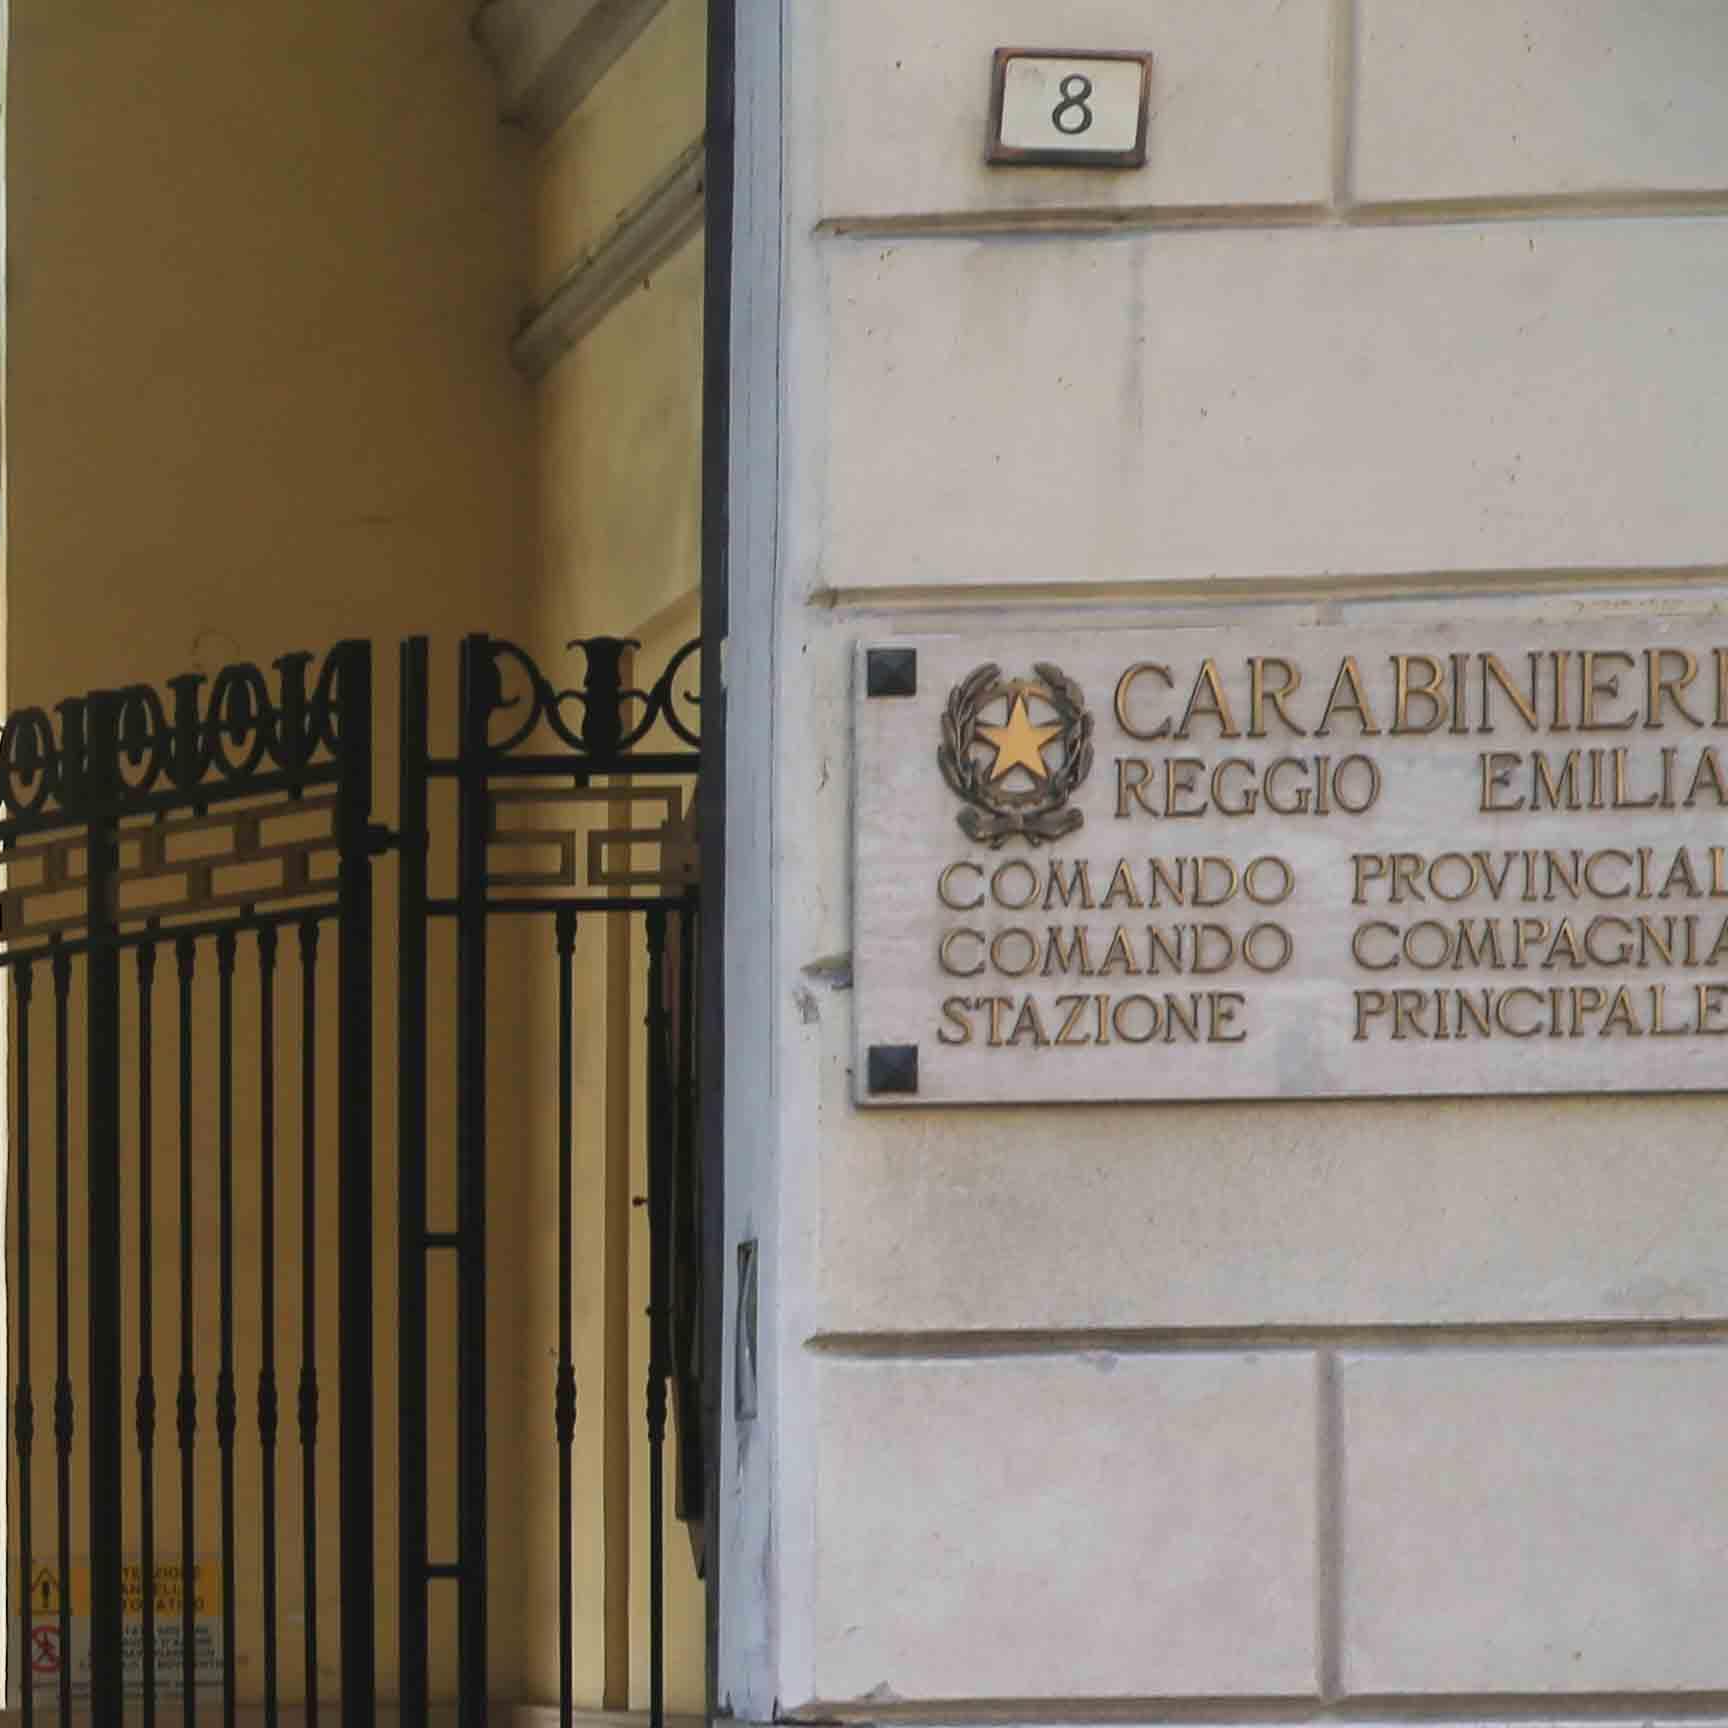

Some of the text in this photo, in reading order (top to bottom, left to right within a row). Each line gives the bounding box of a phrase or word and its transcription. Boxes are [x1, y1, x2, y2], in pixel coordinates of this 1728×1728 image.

[1052, 73, 1093, 135] 8
[1114, 745, 1728, 819] REGGIO EMILIA
[938, 855, 1295, 912] COMANDO
[940, 922, 1293, 979] COMANDO
[936, 983, 1728, 1048] STAZIONE PRINCIPALE
